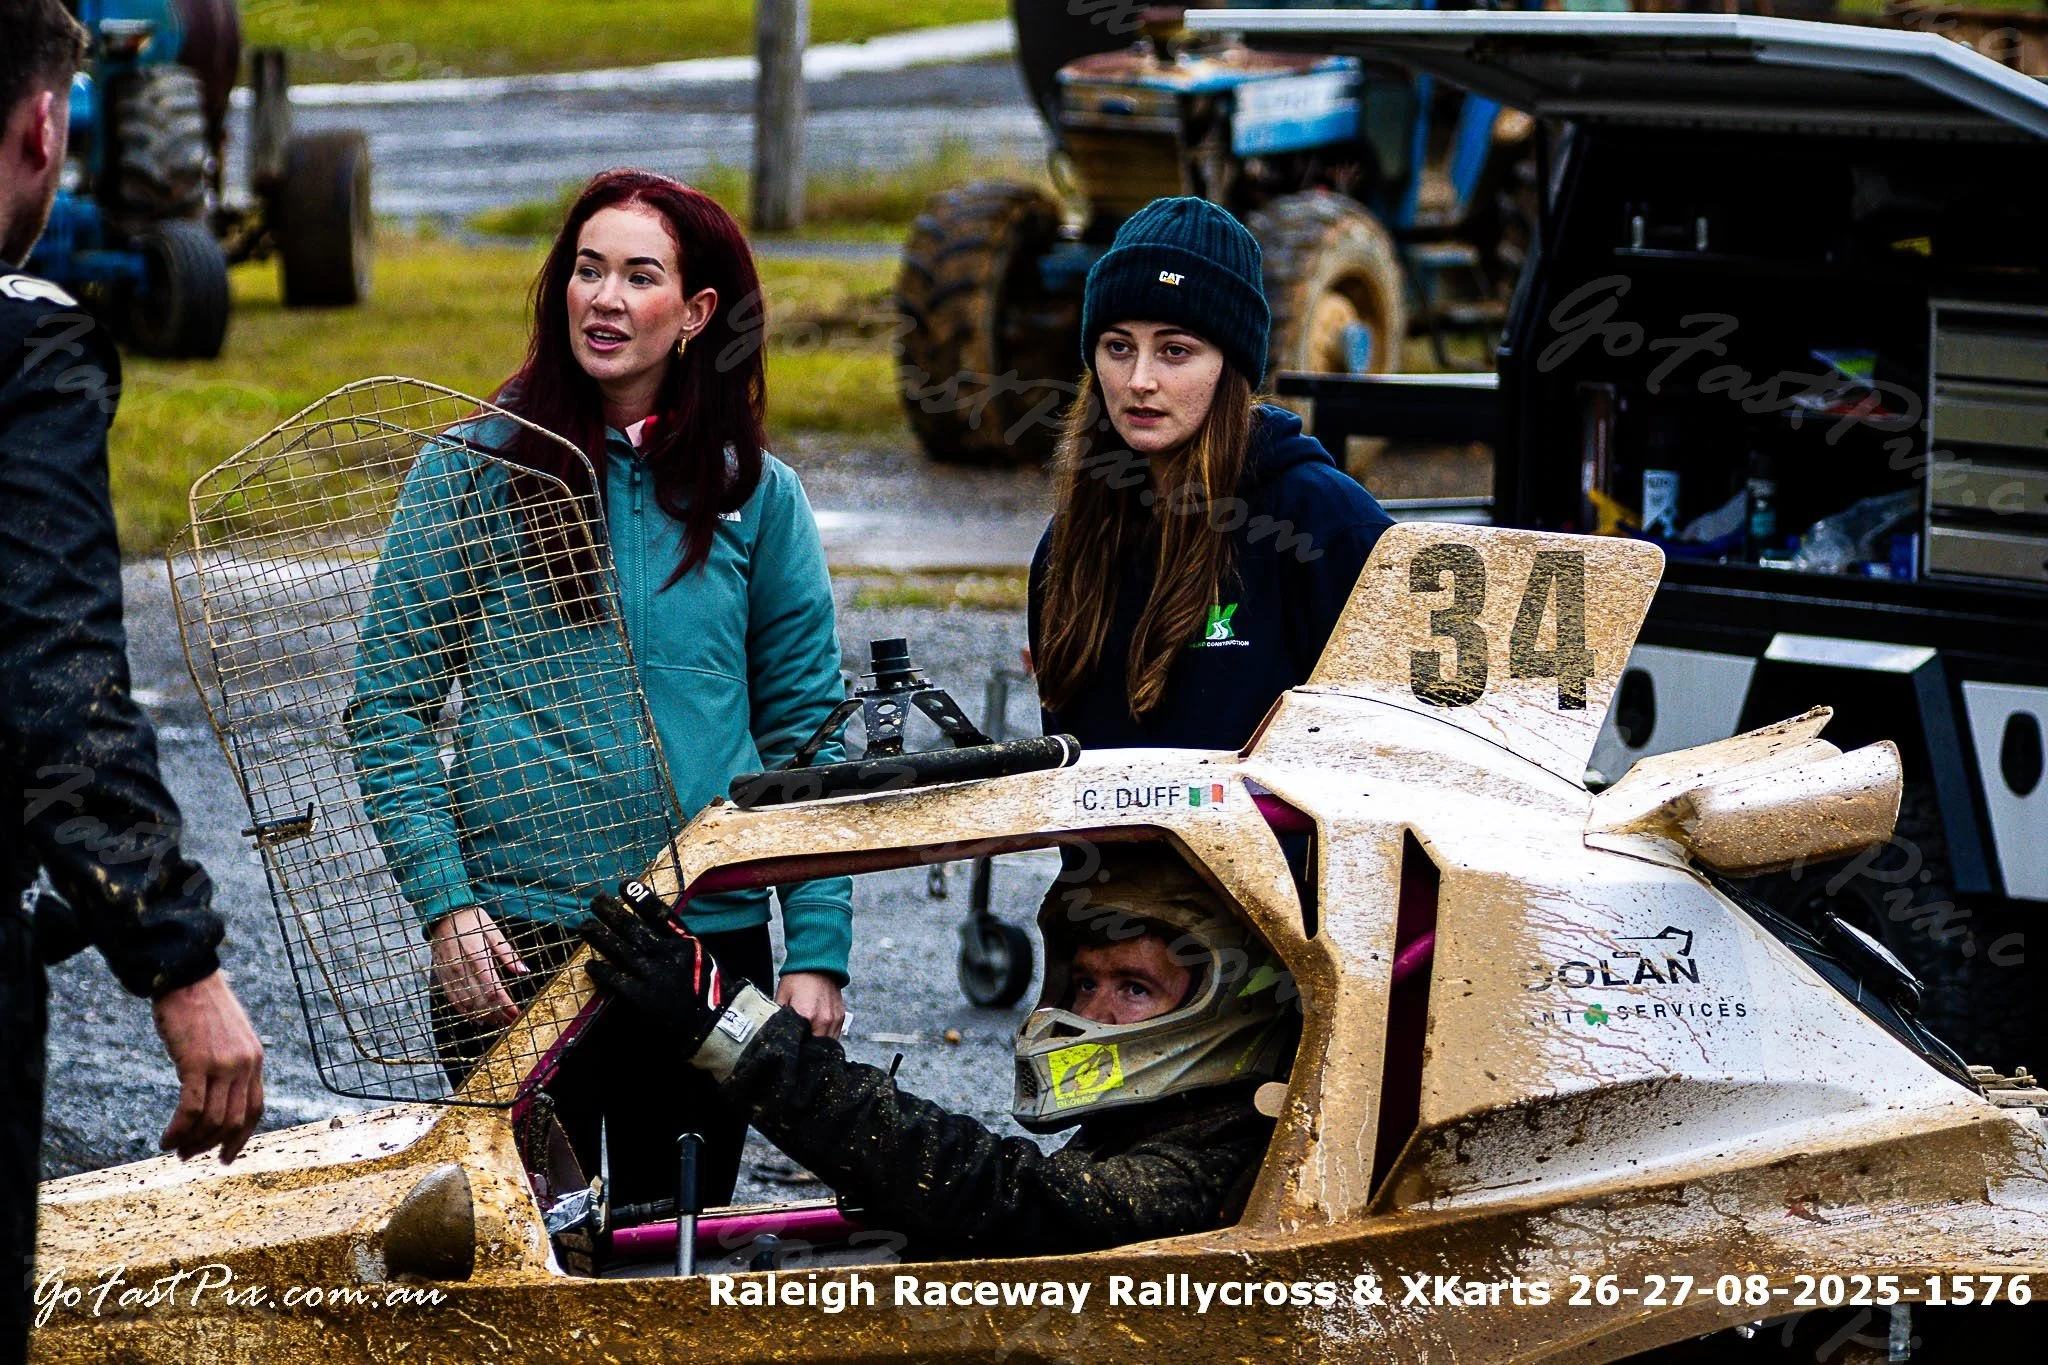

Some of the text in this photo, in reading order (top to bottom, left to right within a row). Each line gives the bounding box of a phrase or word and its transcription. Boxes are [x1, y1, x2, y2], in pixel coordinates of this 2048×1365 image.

[1159, 270, 1185, 286] CAT
[1410, 543, 1595, 710] 34
[1082, 785, 1181, 811] C. DUFF
[1616, 1002, 1748, 1021] SERVICES
